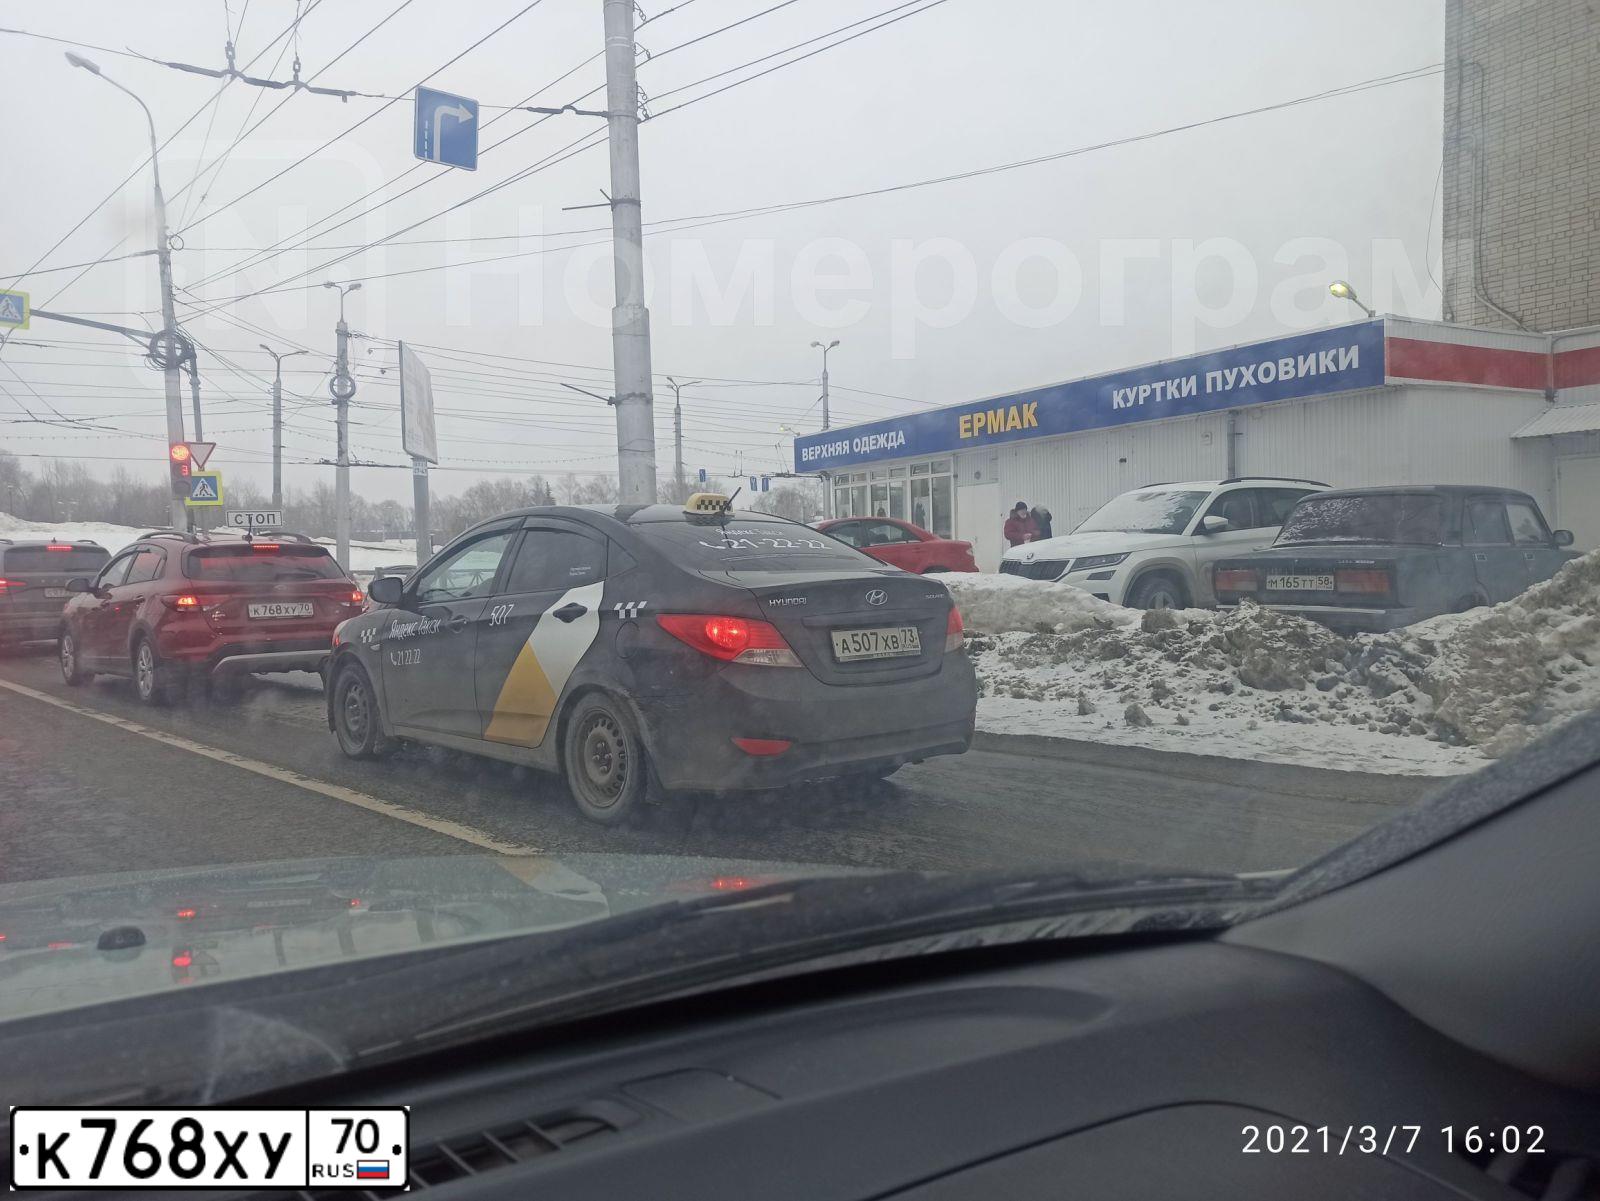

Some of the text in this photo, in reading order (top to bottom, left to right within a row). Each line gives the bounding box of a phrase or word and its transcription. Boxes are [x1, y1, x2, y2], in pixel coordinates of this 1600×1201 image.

[1112, 344, 1359, 410] КУРТКИ ПУХОВИКИ
[959, 402, 1038, 439] ЕРМАК
[802, 430, 906, 462] ВЕРХНЯЯ ОДЕЖДА
[234, 513, 276, 525] СТОП
[1270, 576, 1330, 589] М165ТТ 58
[253, 603, 310, 616] К768ХУ 70
[769, 597, 807, 607] HYUNDAI
[489, 603, 515, 627] 507
[388, 619, 418, 641] Яндекс
[840, 629, 915, 655] А507ХВ 73
